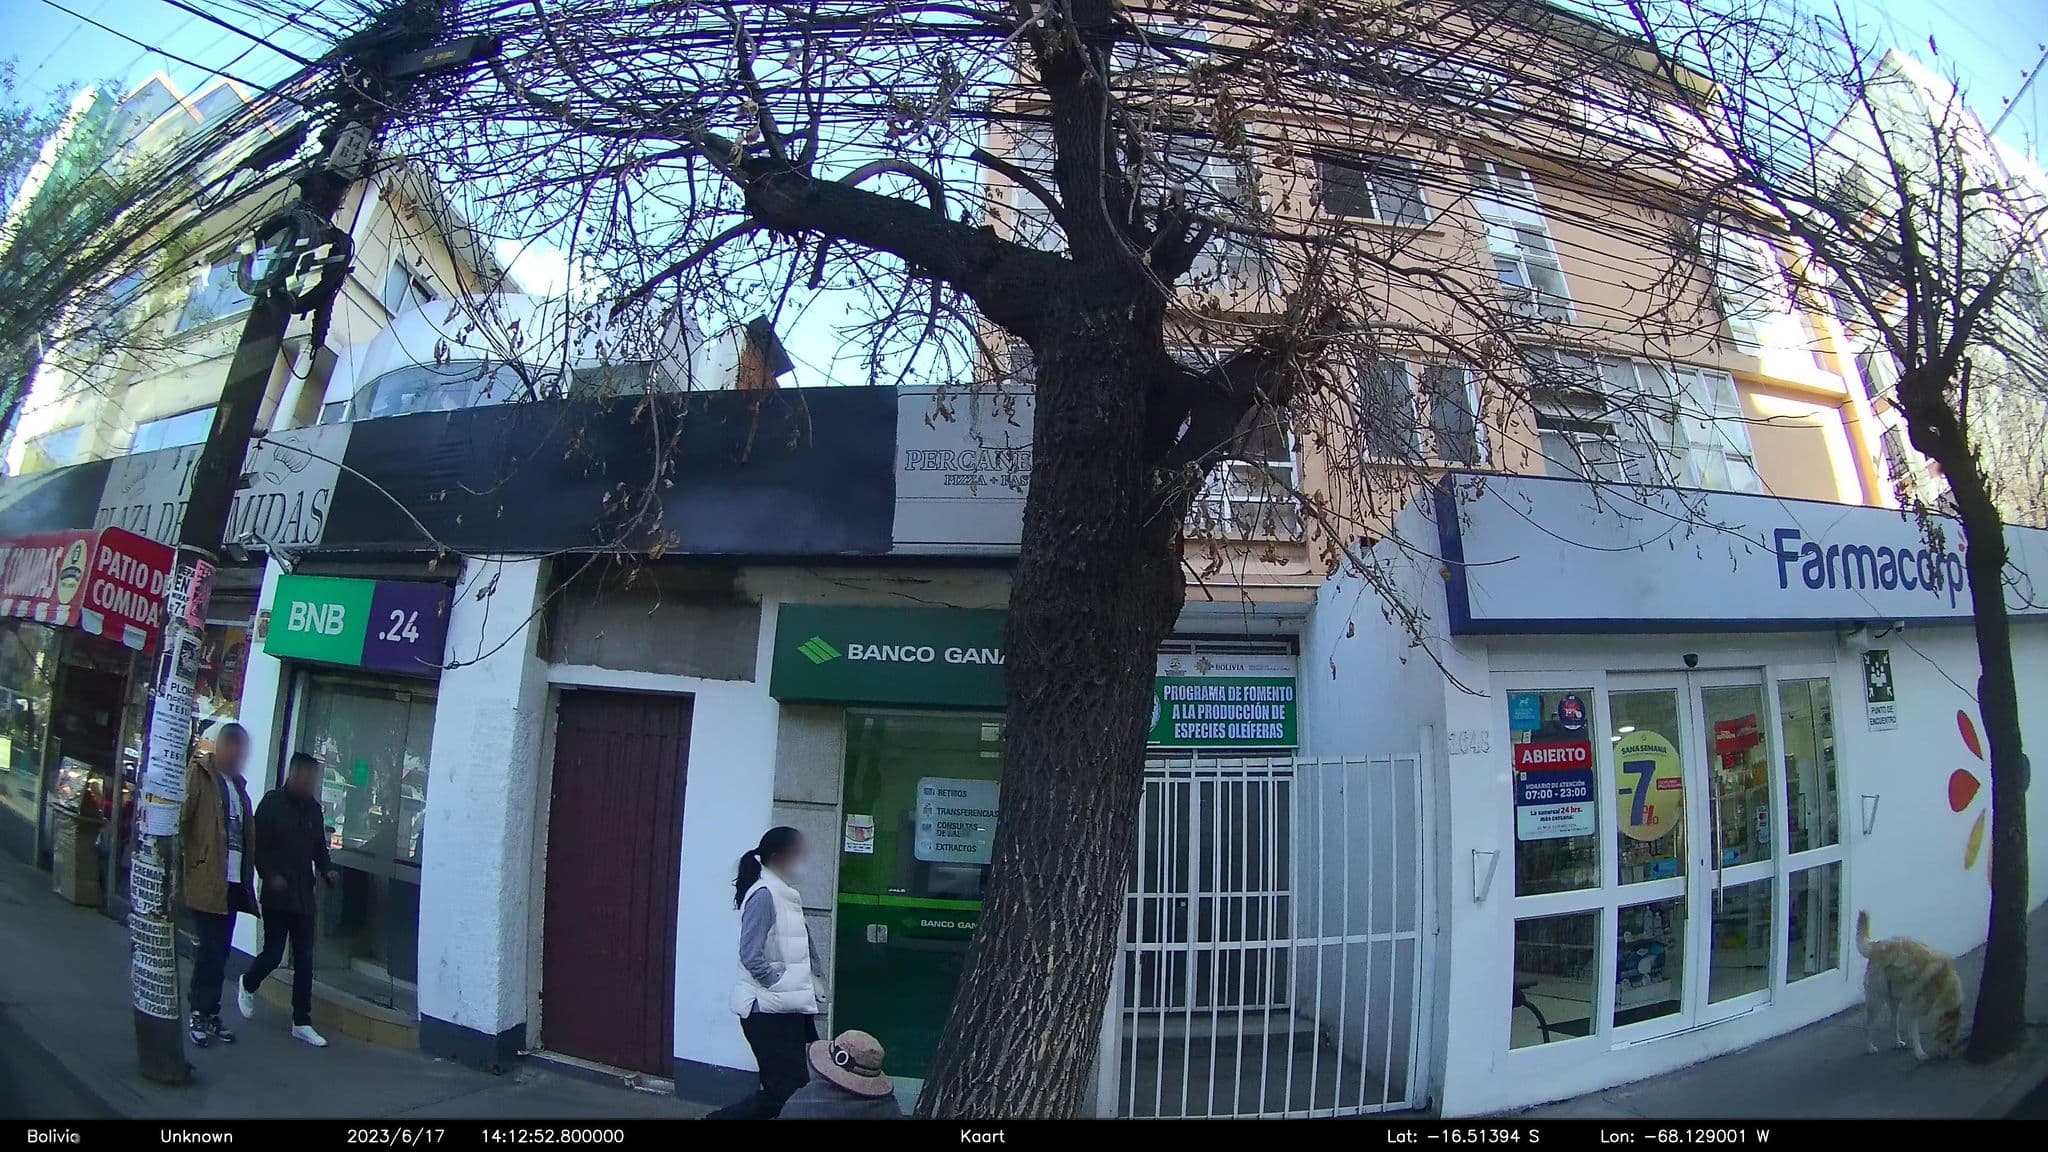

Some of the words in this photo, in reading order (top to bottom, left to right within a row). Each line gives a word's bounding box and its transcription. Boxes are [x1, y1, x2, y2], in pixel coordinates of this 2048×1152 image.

[944, 474, 987, 486] PIZZA
[224, 488, 330, 544] MIDAS
[97, 545, 149, 589] PATIO
[1774, 528, 1964, 609] Farmacorp
[93, 578, 163, 628] COMIDA
[288, 601, 346, 635] BNB
[379, 609, 419, 643] .24
[847, 643, 935, 662] BANCO
[1164, 685, 1225, 701] PROGRAMA
[1228, 685, 1242, 701] DE
[1243, 685, 1293, 701] FOMENTO
[1172, 704, 1180, 720] A
[1182, 704, 1196, 720] LA
[1199, 702, 1270, 720] PRODUCCIÓN
[1271, 704, 1286, 720] DE
[1174, 722, 1226, 739] ESPECIES
[1228, 721, 1284, 739] OLEÍFERAS
[1522, 747, 1586, 764] ABIERTO
[1621, 745, 1640, 755] SANA
[1640, 744, 1667, 754] SEMANA
[1525, 782, 1551, 790] HORARIO
[1525, 789, 1553, 800] 07:00
[1560, 787, 1586, 798] 23:00
[937, 807, 999, 819] TRANSFERENCIAS
[935, 842, 977, 853] EXTRACTOS
[920, 919, 955, 929] BANCO
